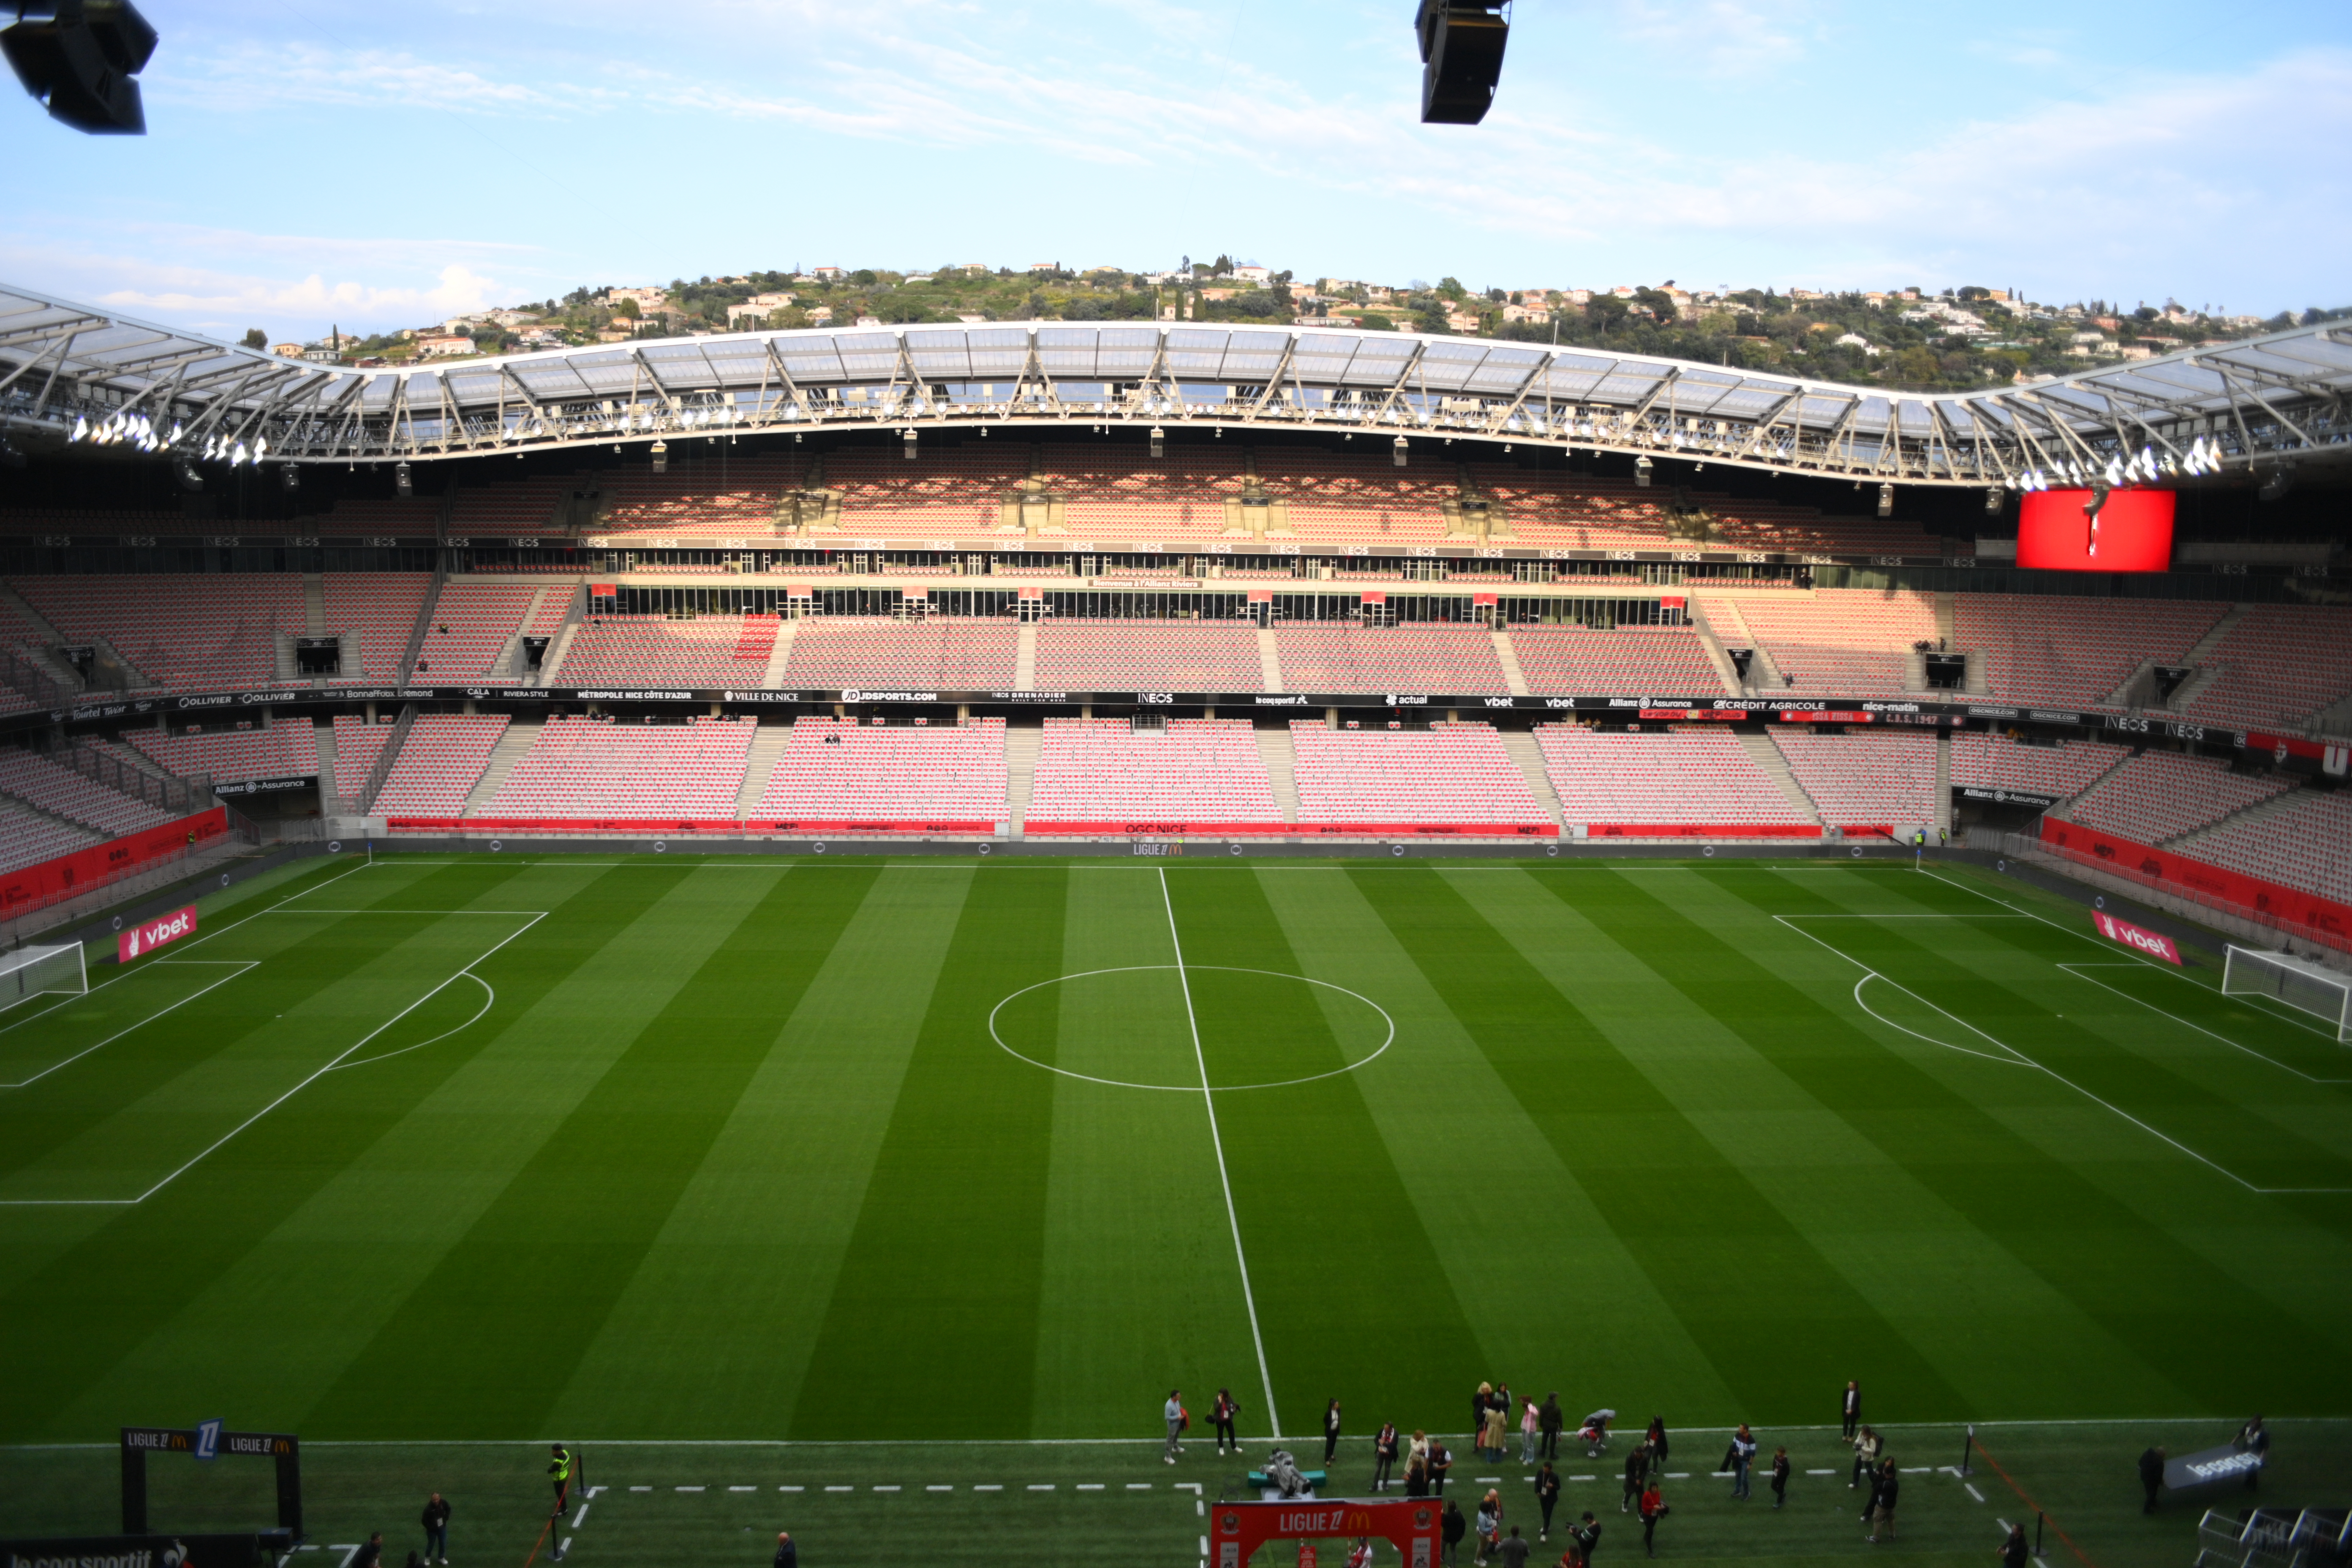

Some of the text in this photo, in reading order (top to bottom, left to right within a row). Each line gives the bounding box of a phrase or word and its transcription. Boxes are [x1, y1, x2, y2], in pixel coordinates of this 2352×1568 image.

[33, 536, 71, 546] INEOS
[120, 536, 156, 546] INEOS
[204, 537, 239, 546] INEOS
[285, 537, 319, 546] INEOS
[363, 538, 396, 547] INEOS
[440, 538, 469, 547] INEOS
[509, 538, 539, 547] INEOS
[578, 539, 608, 547] INEOS
[647, 539, 677, 548] INEOS
[716, 539, 747, 548] INEOS
[785, 540, 816, 549] INEOS
[855, 540, 885, 549] INEOS
[925, 541, 955, 550] INEOS
[994, 542, 1024, 551] INEOS
[1064, 542, 1094, 551] INEOS
[1132, 543, 1162, 552] INEOS
[1202, 544, 1232, 553] INEOS
[1270, 545, 1300, 554] INEOS
[1339, 546, 1369, 555] INEOS
[1406, 547, 1436, 555] INEOS
[1474, 548, 1503, 557] INEOS
[1540, 549, 1569, 558] INEOS
[1606, 551, 1635, 560] INEOS
[1671, 552, 1700, 561] INEOS
[1737, 553, 1765, 562] INEOS
[1802, 555, 1832, 564] INEOS
[1870, 556, 1901, 565] INEOS
[1943, 558, 1975, 567] INEOS
[2213, 564, 2247, 574] INEOS
[2293, 566, 2328, 577] INEOS
[253, 692, 295, 701] OLLIVIER
[578, 690, 623, 699] MÉTROPOLE
[645, 690, 664, 699] CÔTE
[735, 692, 798, 701] VILLE DE NICE
[860, 692, 936, 701] JDSPORTS.COM
[1138, 693, 1173, 703] INEOS
[190, 696, 231, 705] OLLIVIER
[1274, 697, 1295, 705] sportif
[1399, 695, 1427, 704] actual
[1484, 697, 1513, 707] vbet
[1546, 698, 1574, 708] vbet
[1609, 699, 1692, 707] Allianz Assurance
[1726, 700, 1766, 709] CRÉDIT
[1863, 702, 1918, 711] nice-matin
[74, 706, 127, 720] Tourtel Twist
[1812, 712, 1854, 721] ISSA NISSA
[2033, 713, 2076, 721] OGCNICE.COM
[1886, 714, 1938, 724] C.D.S. 1947
[2105, 716, 2148, 731] INEOS
[2166, 723, 2203, 740] INEOS
[215, 780, 305, 794] Allianz Assurance
[1964, 788, 2050, 806] Allianz Assurance
[1126, 825, 1187, 835] OGC NICE
[1134, 844, 1160, 855] LIGUE
[146, 913, 188, 945] vbet
[2119, 927, 2170, 958] vbet
[128, 1433, 158, 1447] LIGUE
[231, 1437, 261, 1451] LIGUE
[2186, 1464, 2213, 1477] le
[2206, 1456, 2248, 1473] coq
[1280, 1513, 1326, 1532] LIGUE
[12, 1554, 31, 1568] le
